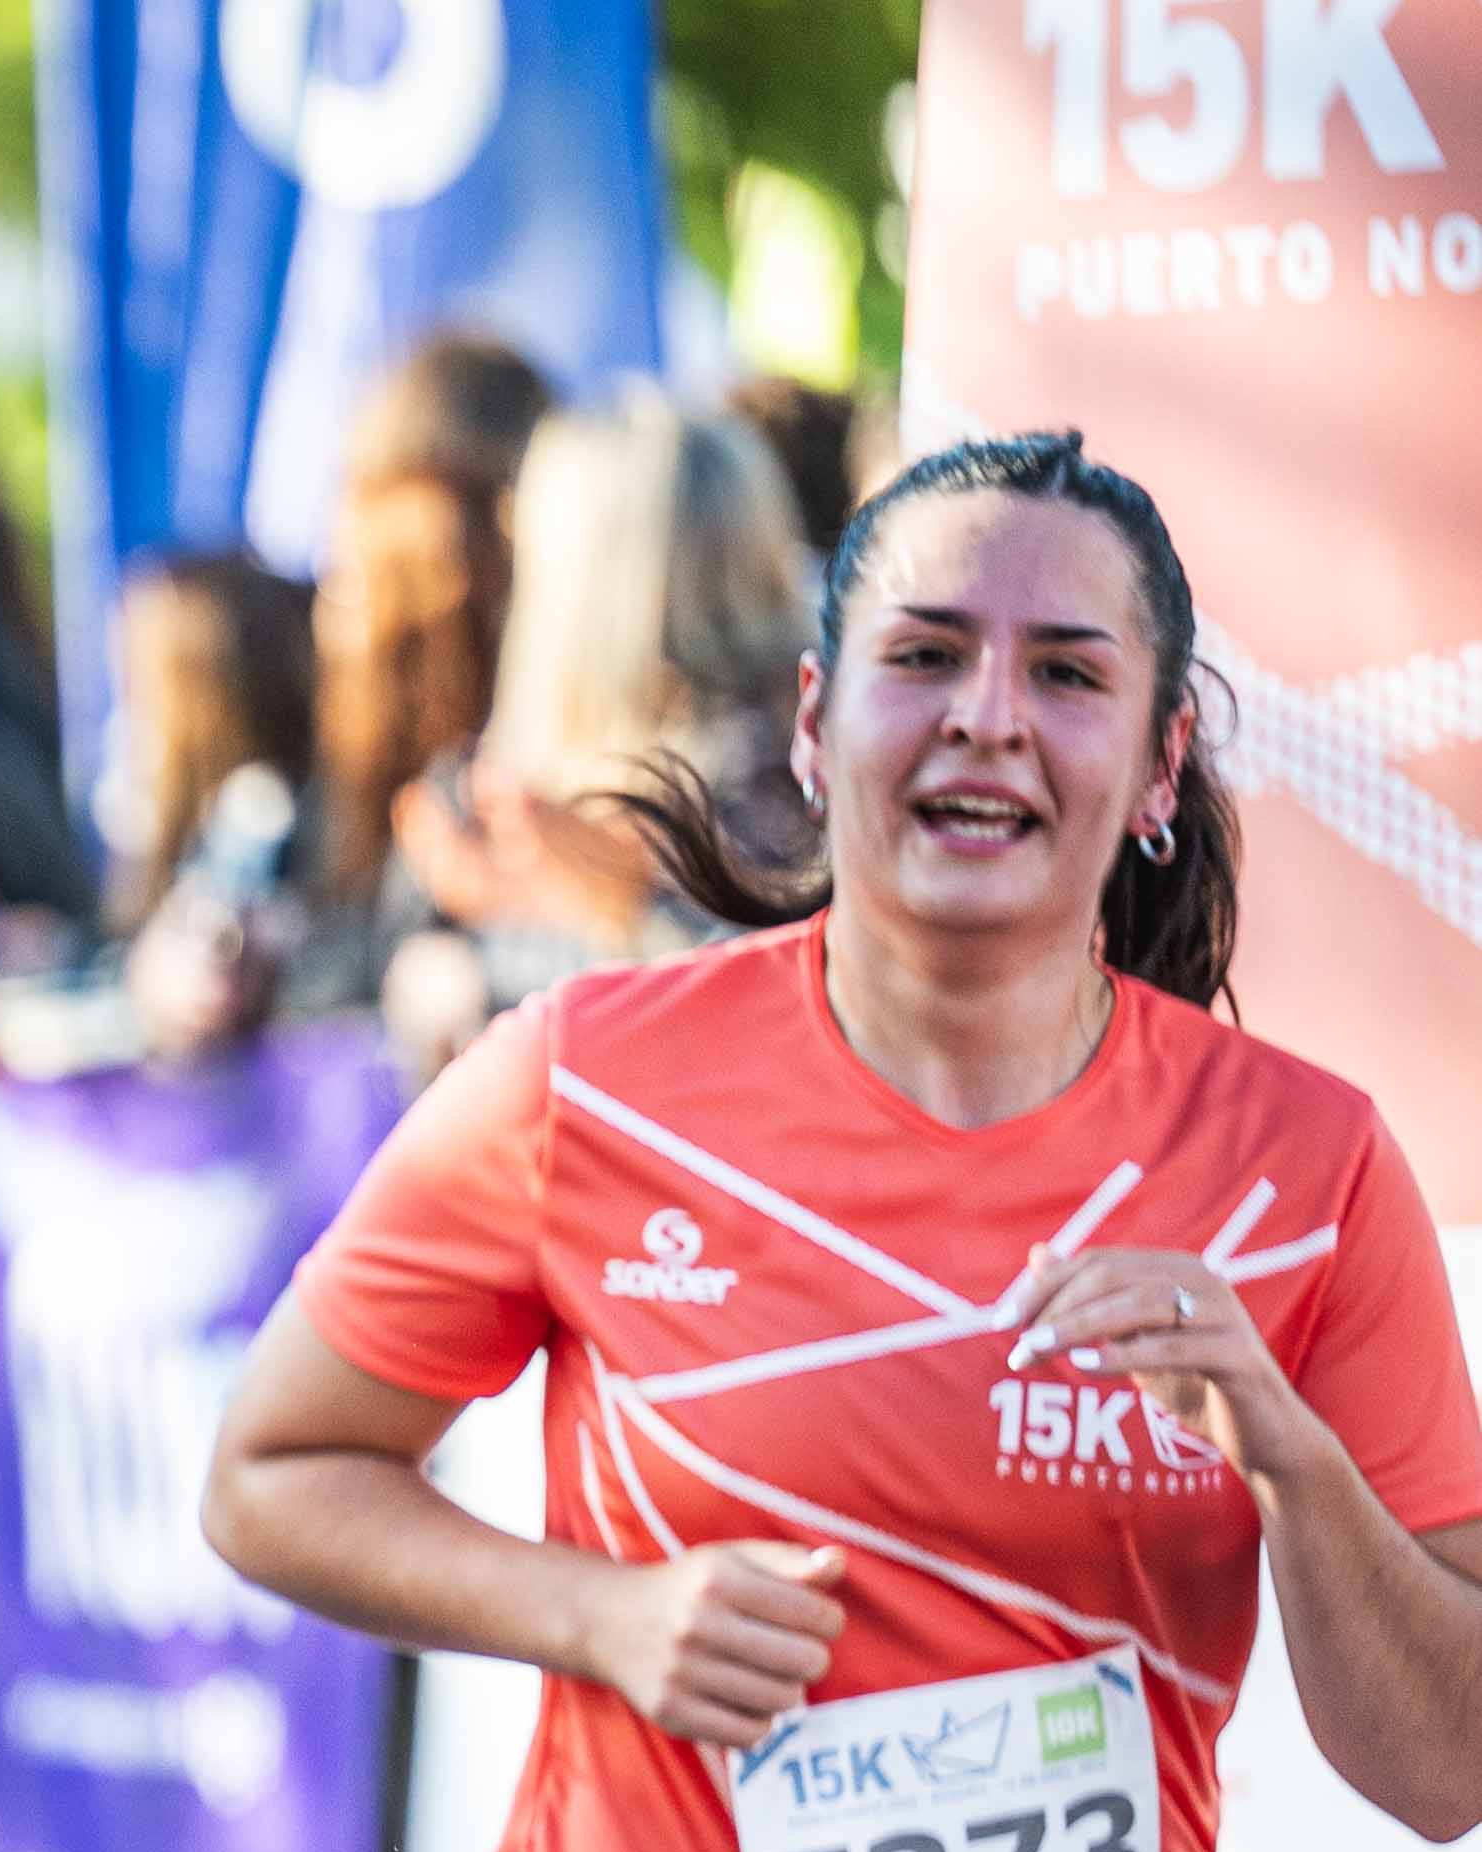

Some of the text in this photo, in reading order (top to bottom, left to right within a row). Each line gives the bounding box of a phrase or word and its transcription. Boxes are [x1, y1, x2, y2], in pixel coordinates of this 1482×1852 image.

[1021, 0, 1447, 196] 15K
[1015, 218, 1335, 326] PUERTO
[989, 1378, 1135, 1467] 15K
[780, 1739, 892, 1807] 15K
